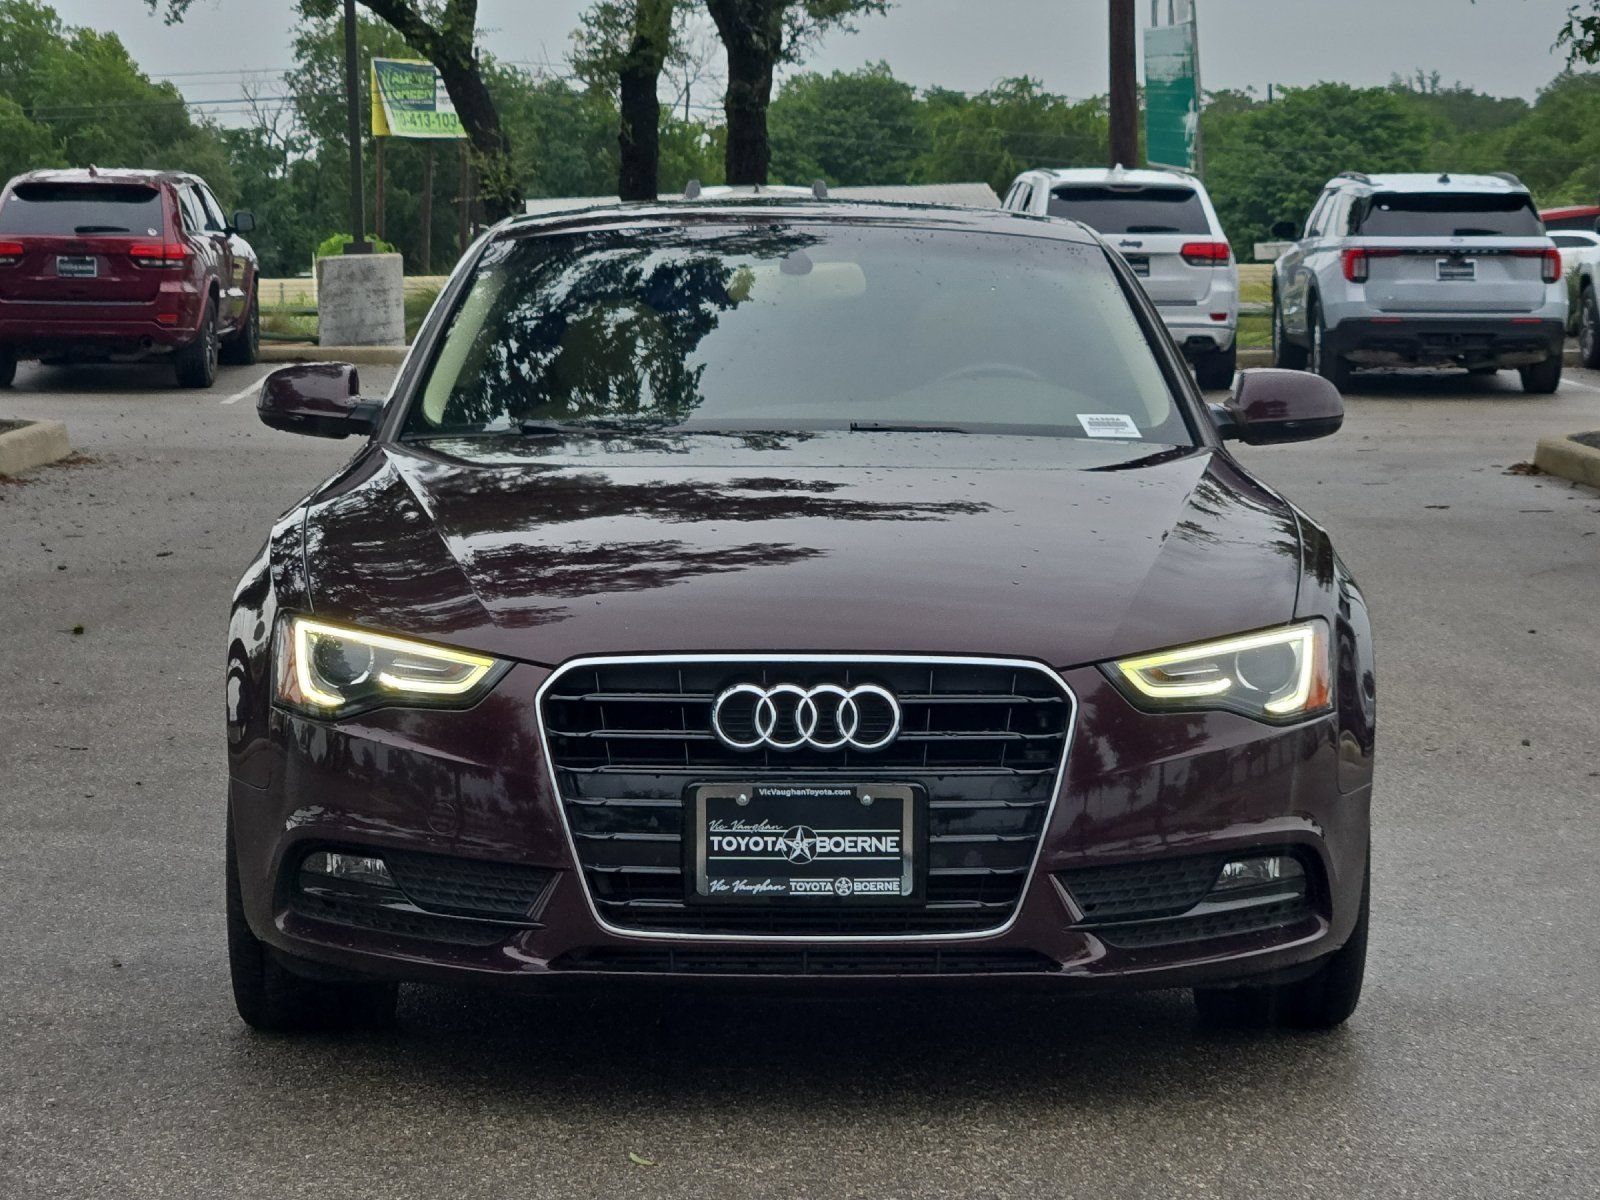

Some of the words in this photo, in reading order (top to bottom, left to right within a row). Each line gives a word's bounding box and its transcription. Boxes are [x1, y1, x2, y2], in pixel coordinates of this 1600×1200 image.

[758, 788, 851, 797] VicVaughanToyota.com
[708, 819, 728, 832] Vic
[730, 818, 783, 833] Vaughan
[709, 836, 787, 851] TOYOTA
[816, 836, 900, 853] BOERNE
[709, 878, 730, 893] Vic
[732, 878, 786, 894] Vaughan
[789, 882, 834, 891] TOYOTA
[854, 881, 900, 891] BOERNE
